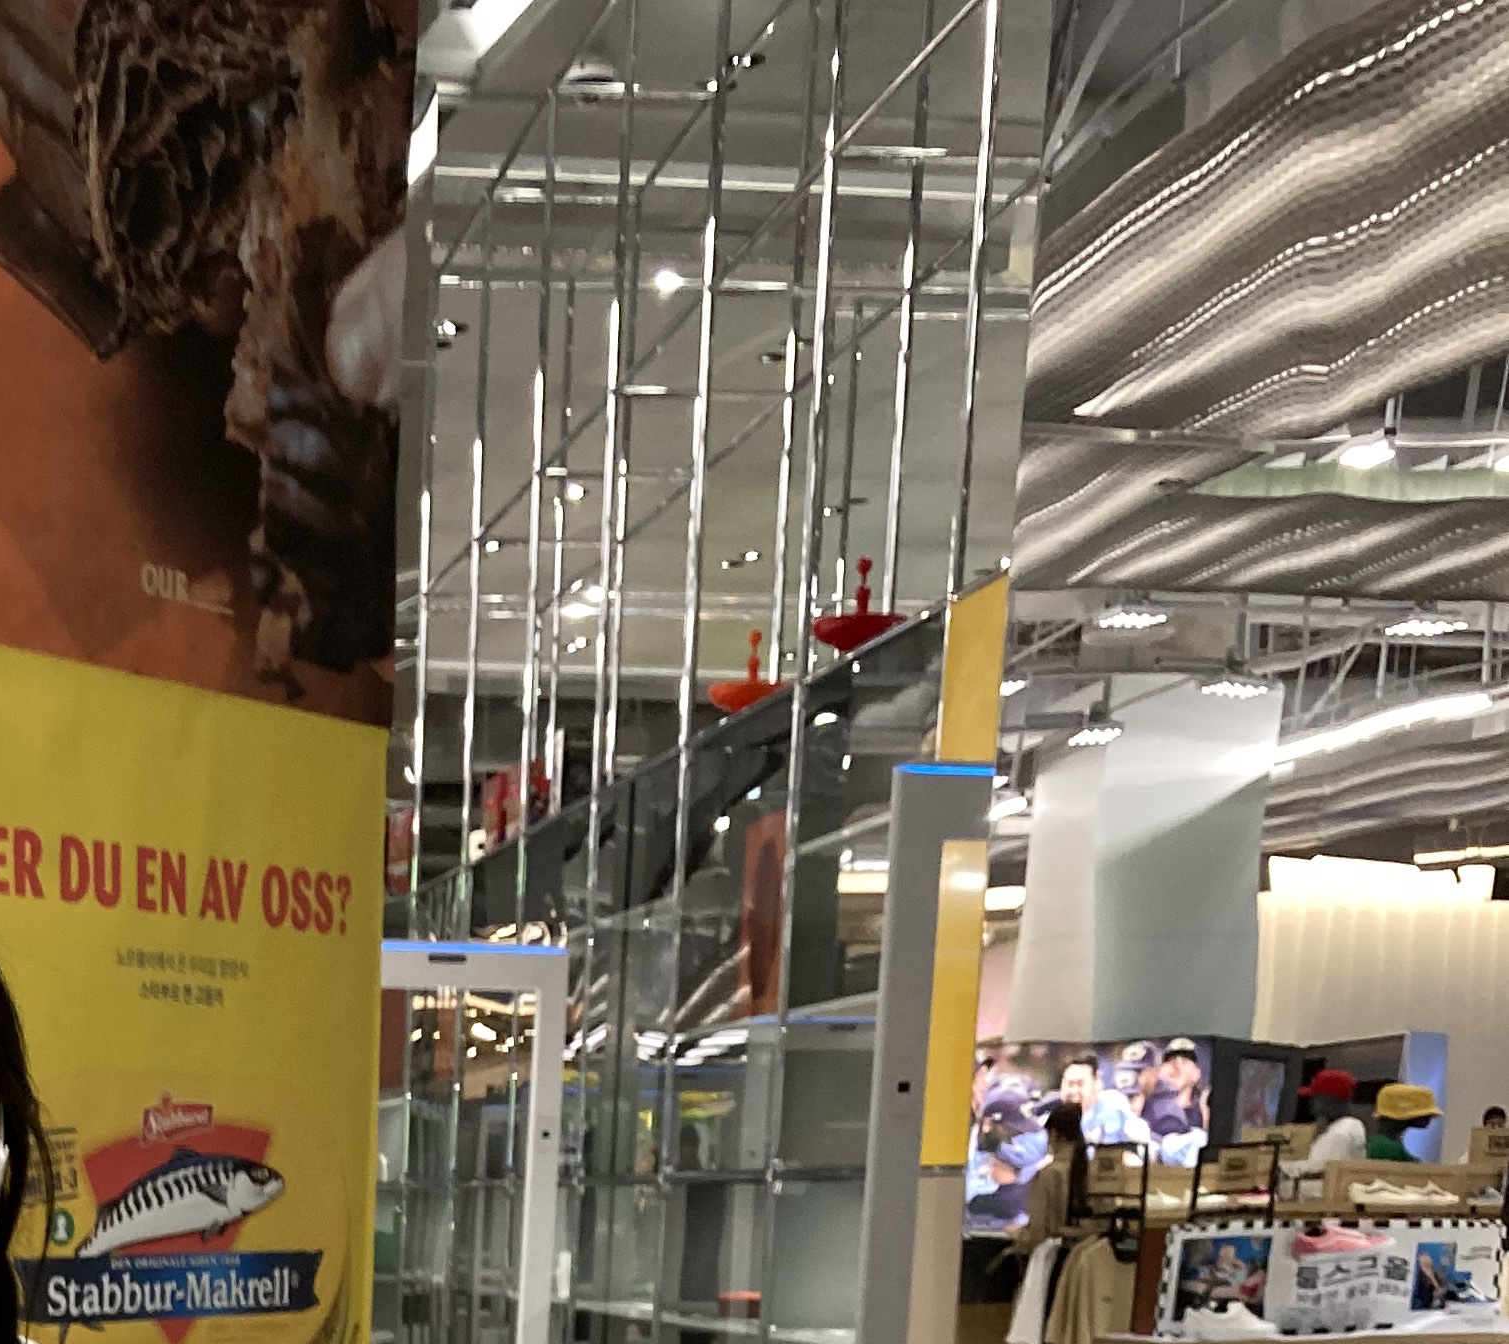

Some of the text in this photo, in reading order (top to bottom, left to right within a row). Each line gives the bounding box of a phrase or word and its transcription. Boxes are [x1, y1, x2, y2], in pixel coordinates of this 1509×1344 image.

[59, 833, 122, 909] DU
[136, 845, 188, 917] EN
[199, 857, 249, 923] AV
[261, 865, 352, 936] OSS?
